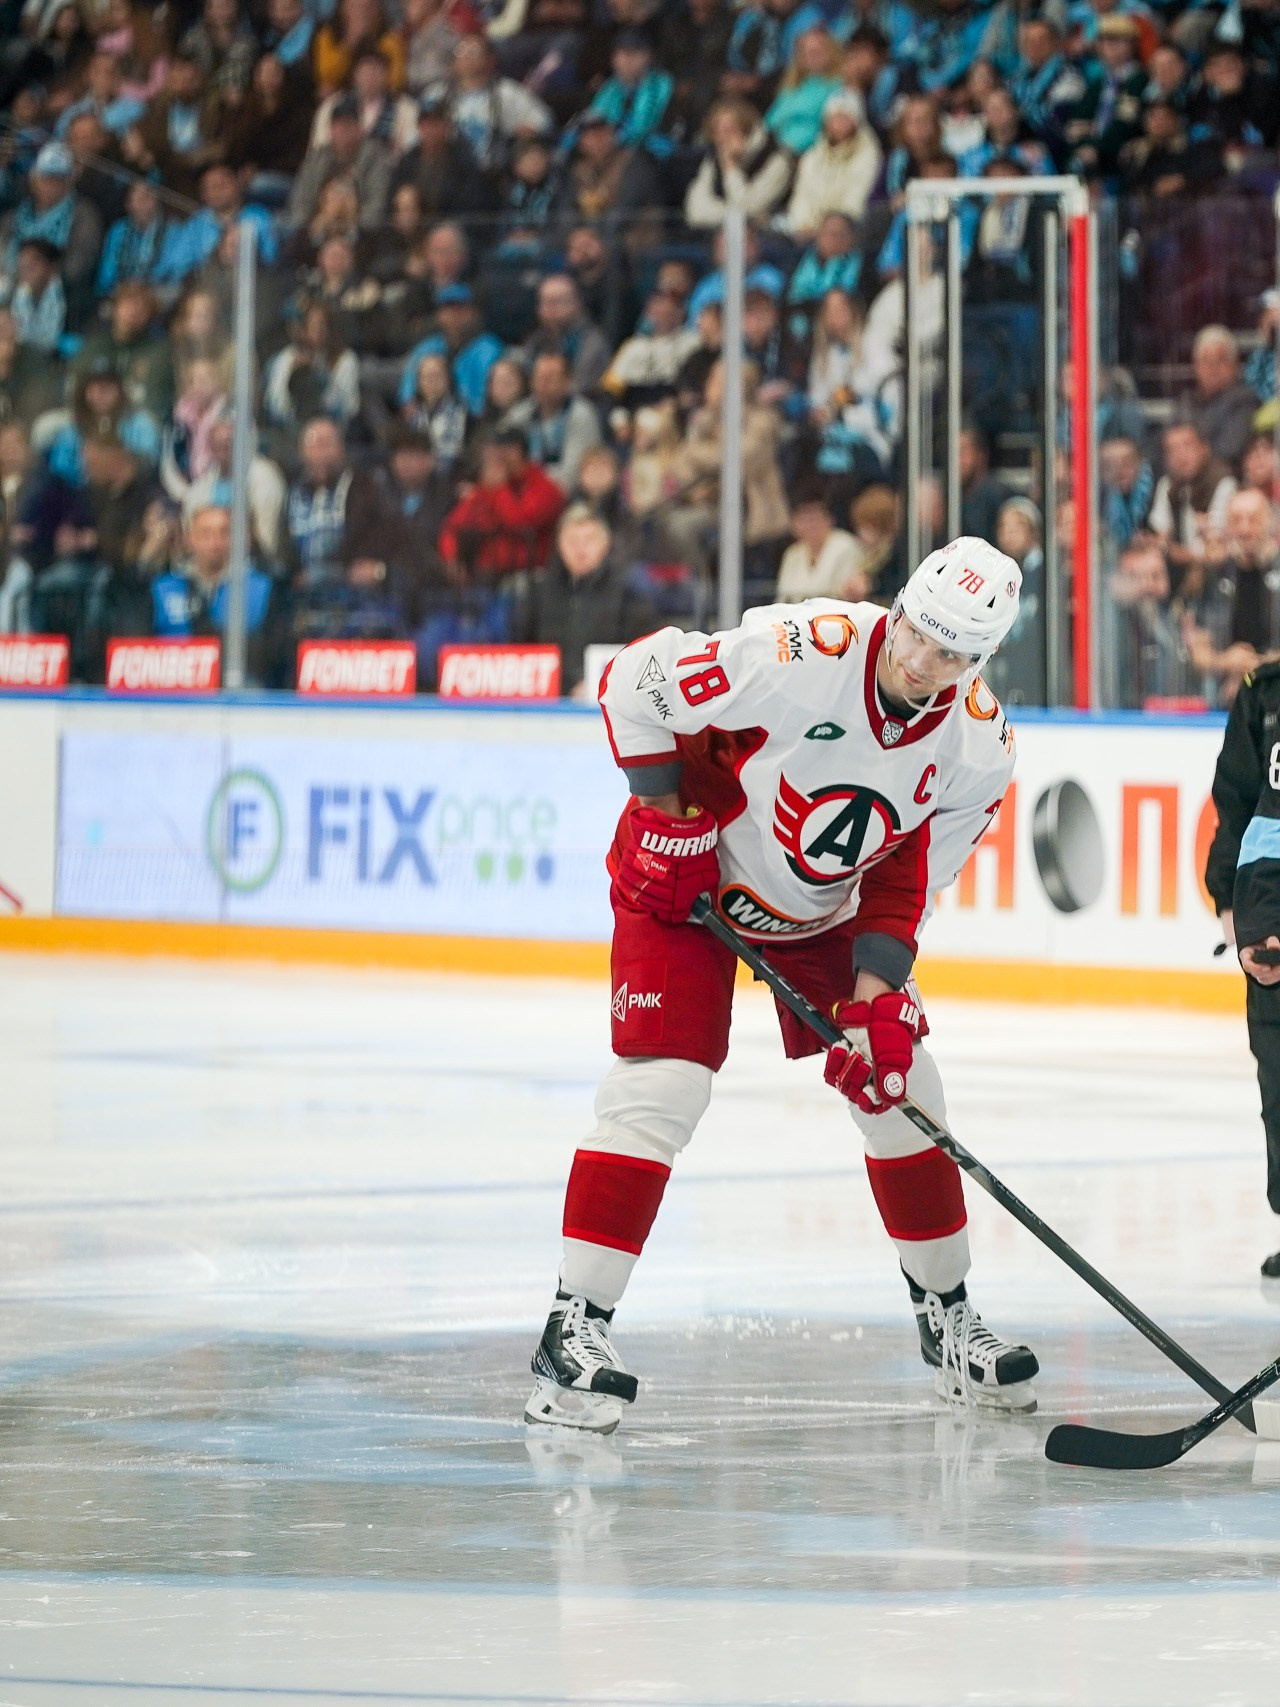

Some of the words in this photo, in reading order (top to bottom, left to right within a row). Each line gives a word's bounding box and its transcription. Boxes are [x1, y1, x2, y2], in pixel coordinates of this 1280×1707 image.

[958, 568, 985, 595] 78
[771, 622, 791, 664] MMC
[108, 645, 220, 689] FONBET
[300, 648, 414, 692] FONBET
[440, 653, 558, 697] FONBET
[677, 640, 731, 707] 78
[913, 763, 937, 805] C
